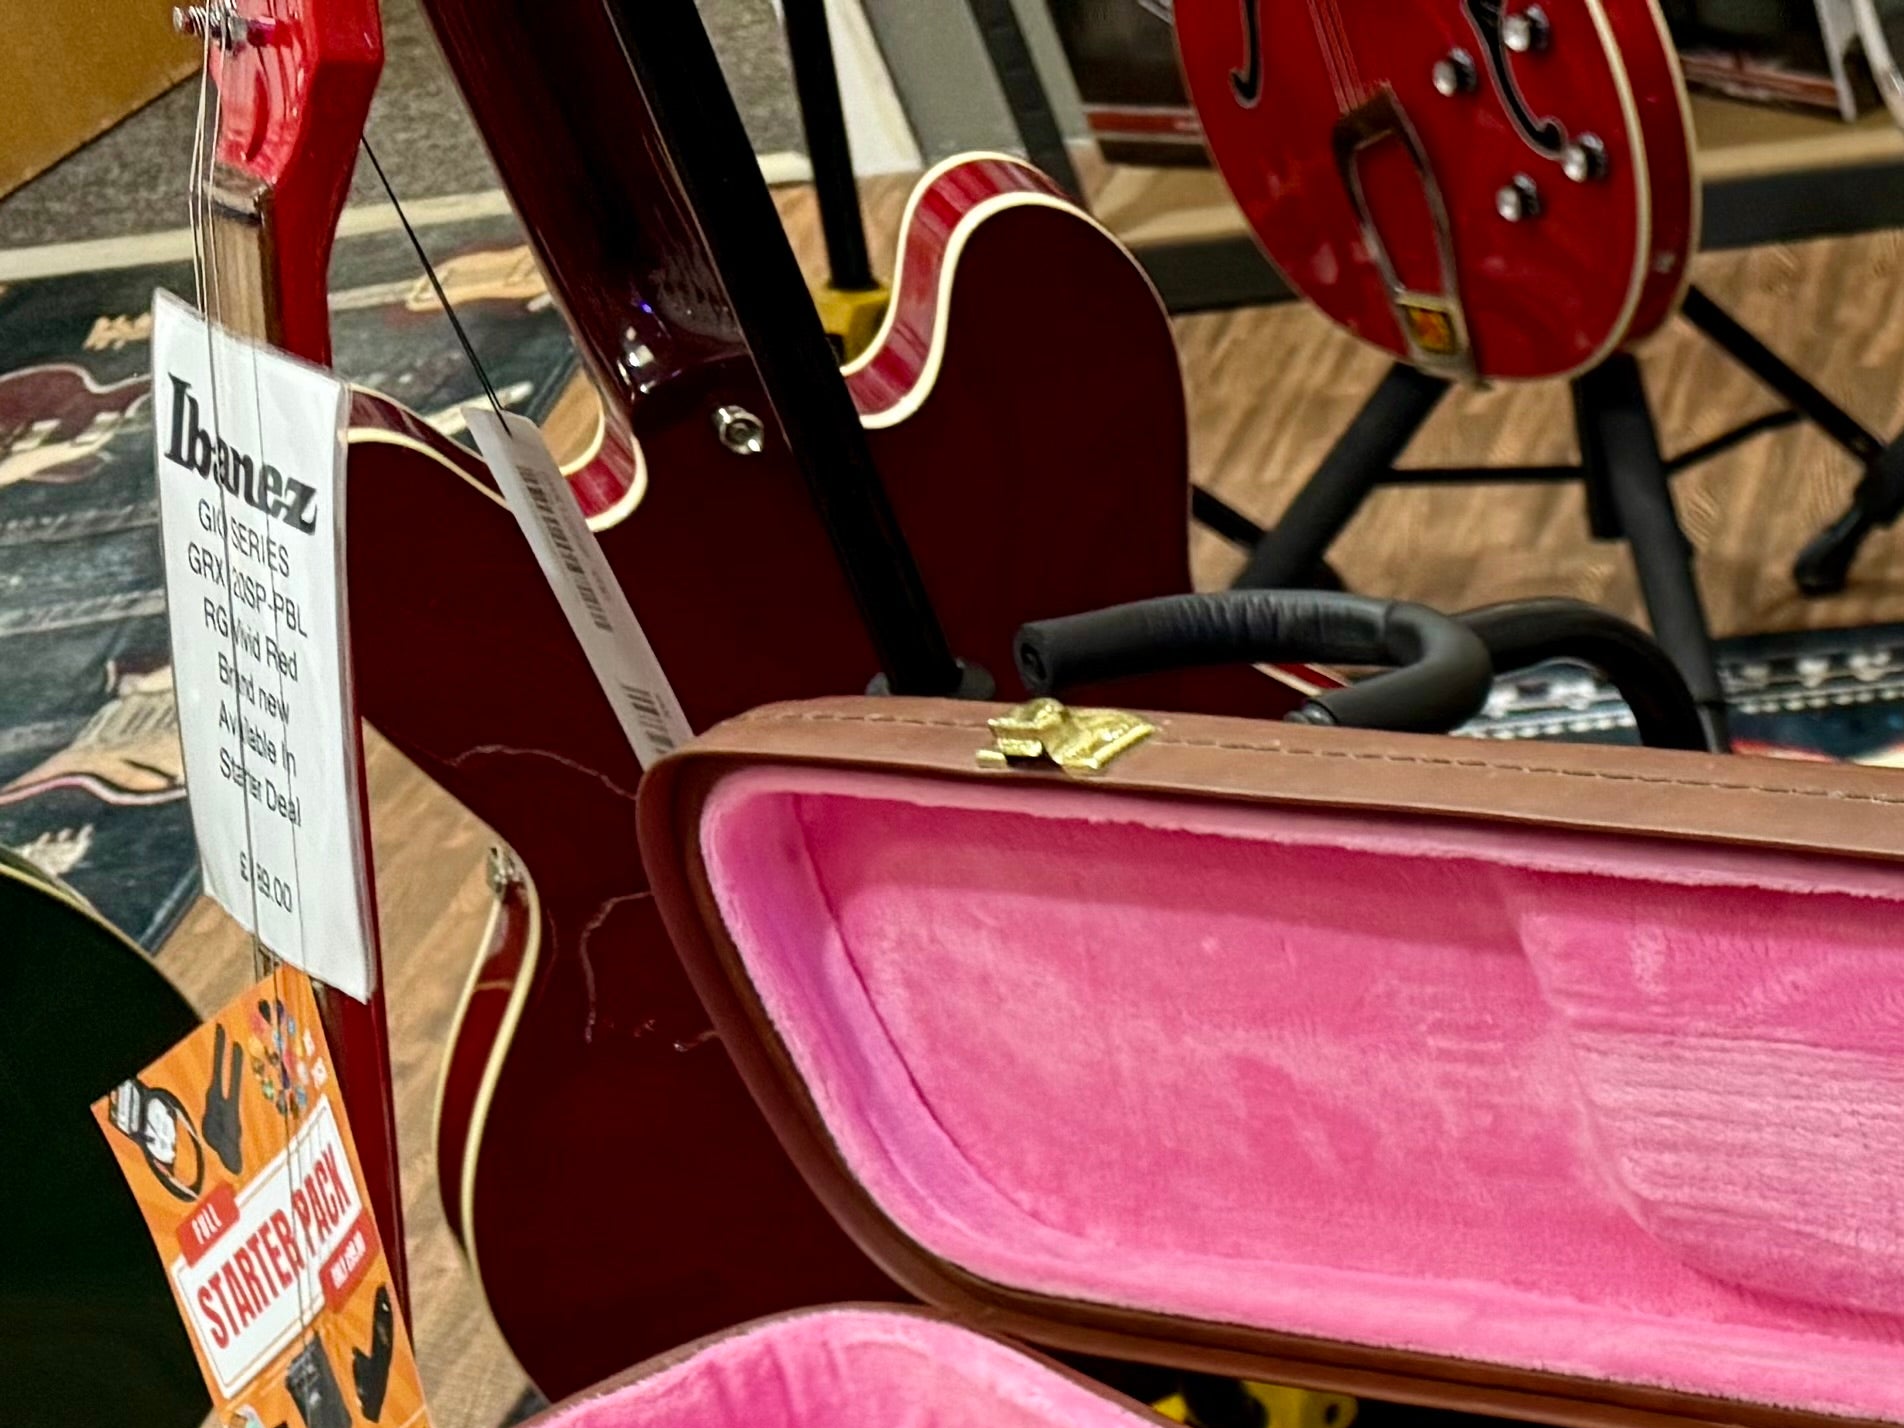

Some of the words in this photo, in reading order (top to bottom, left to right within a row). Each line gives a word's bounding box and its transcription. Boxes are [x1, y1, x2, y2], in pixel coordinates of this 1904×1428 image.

[164, 372, 317, 535] Ibanez
[230, 515, 290, 578] SERIES
[187, 540, 308, 638] GRX20SP-PBL
[203, 595, 229, 638] RG
[265, 635, 298, 683] Red
[218, 651, 256, 706] Brnd
[258, 687, 290, 726] new
[265, 777, 302, 828] Deal
[239, 851, 293, 914] £9.00
[197, 1208, 305, 1349] STARTER
[291, 1142, 352, 1258] PACK
